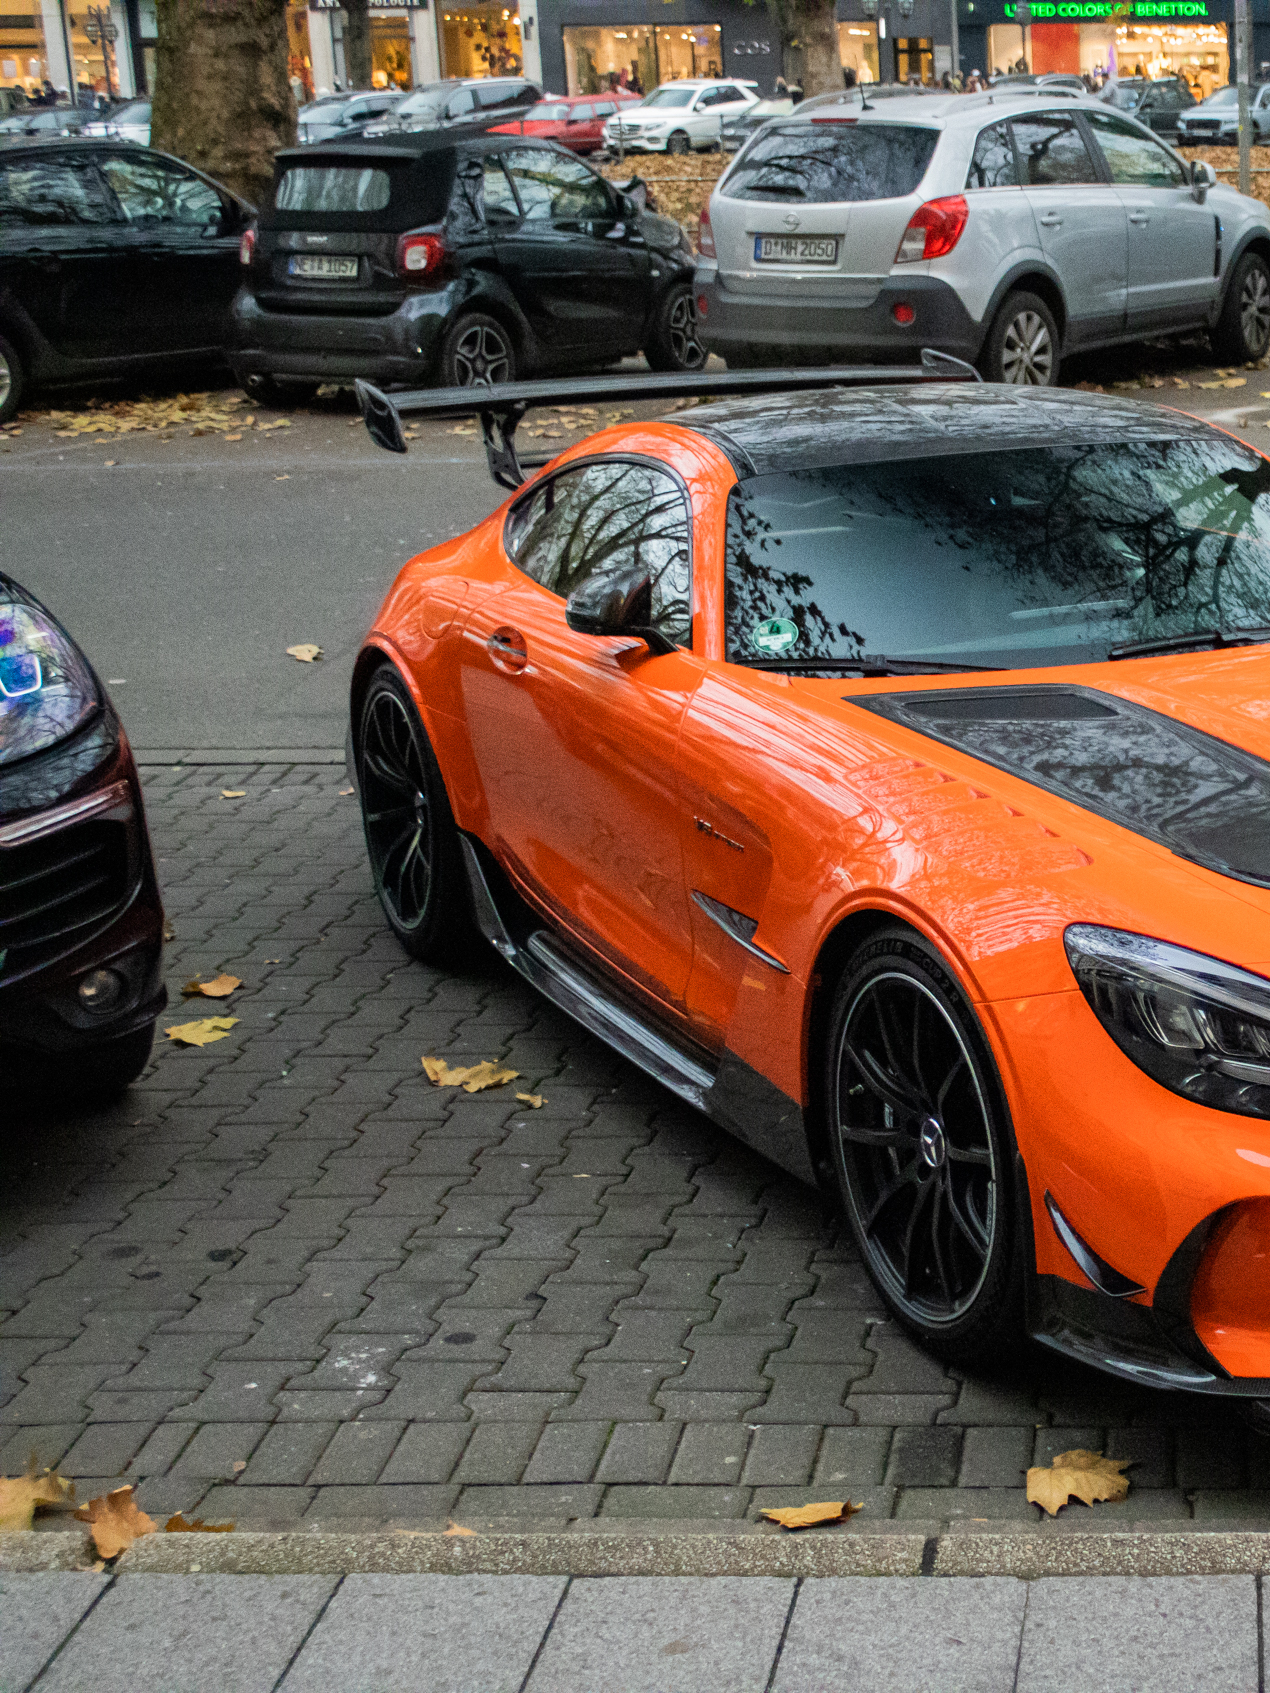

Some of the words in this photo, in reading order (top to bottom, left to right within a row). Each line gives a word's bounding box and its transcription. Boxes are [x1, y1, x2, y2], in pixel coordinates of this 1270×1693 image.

[1004, 2, 1057, 17] UTED
[1057, 2, 1113, 17] COLORS
[733, 40, 771, 55] COS
[764, 240, 772, 256] D
[800, 240, 835, 258] 2050
[769, 621, 781, 635] 4
